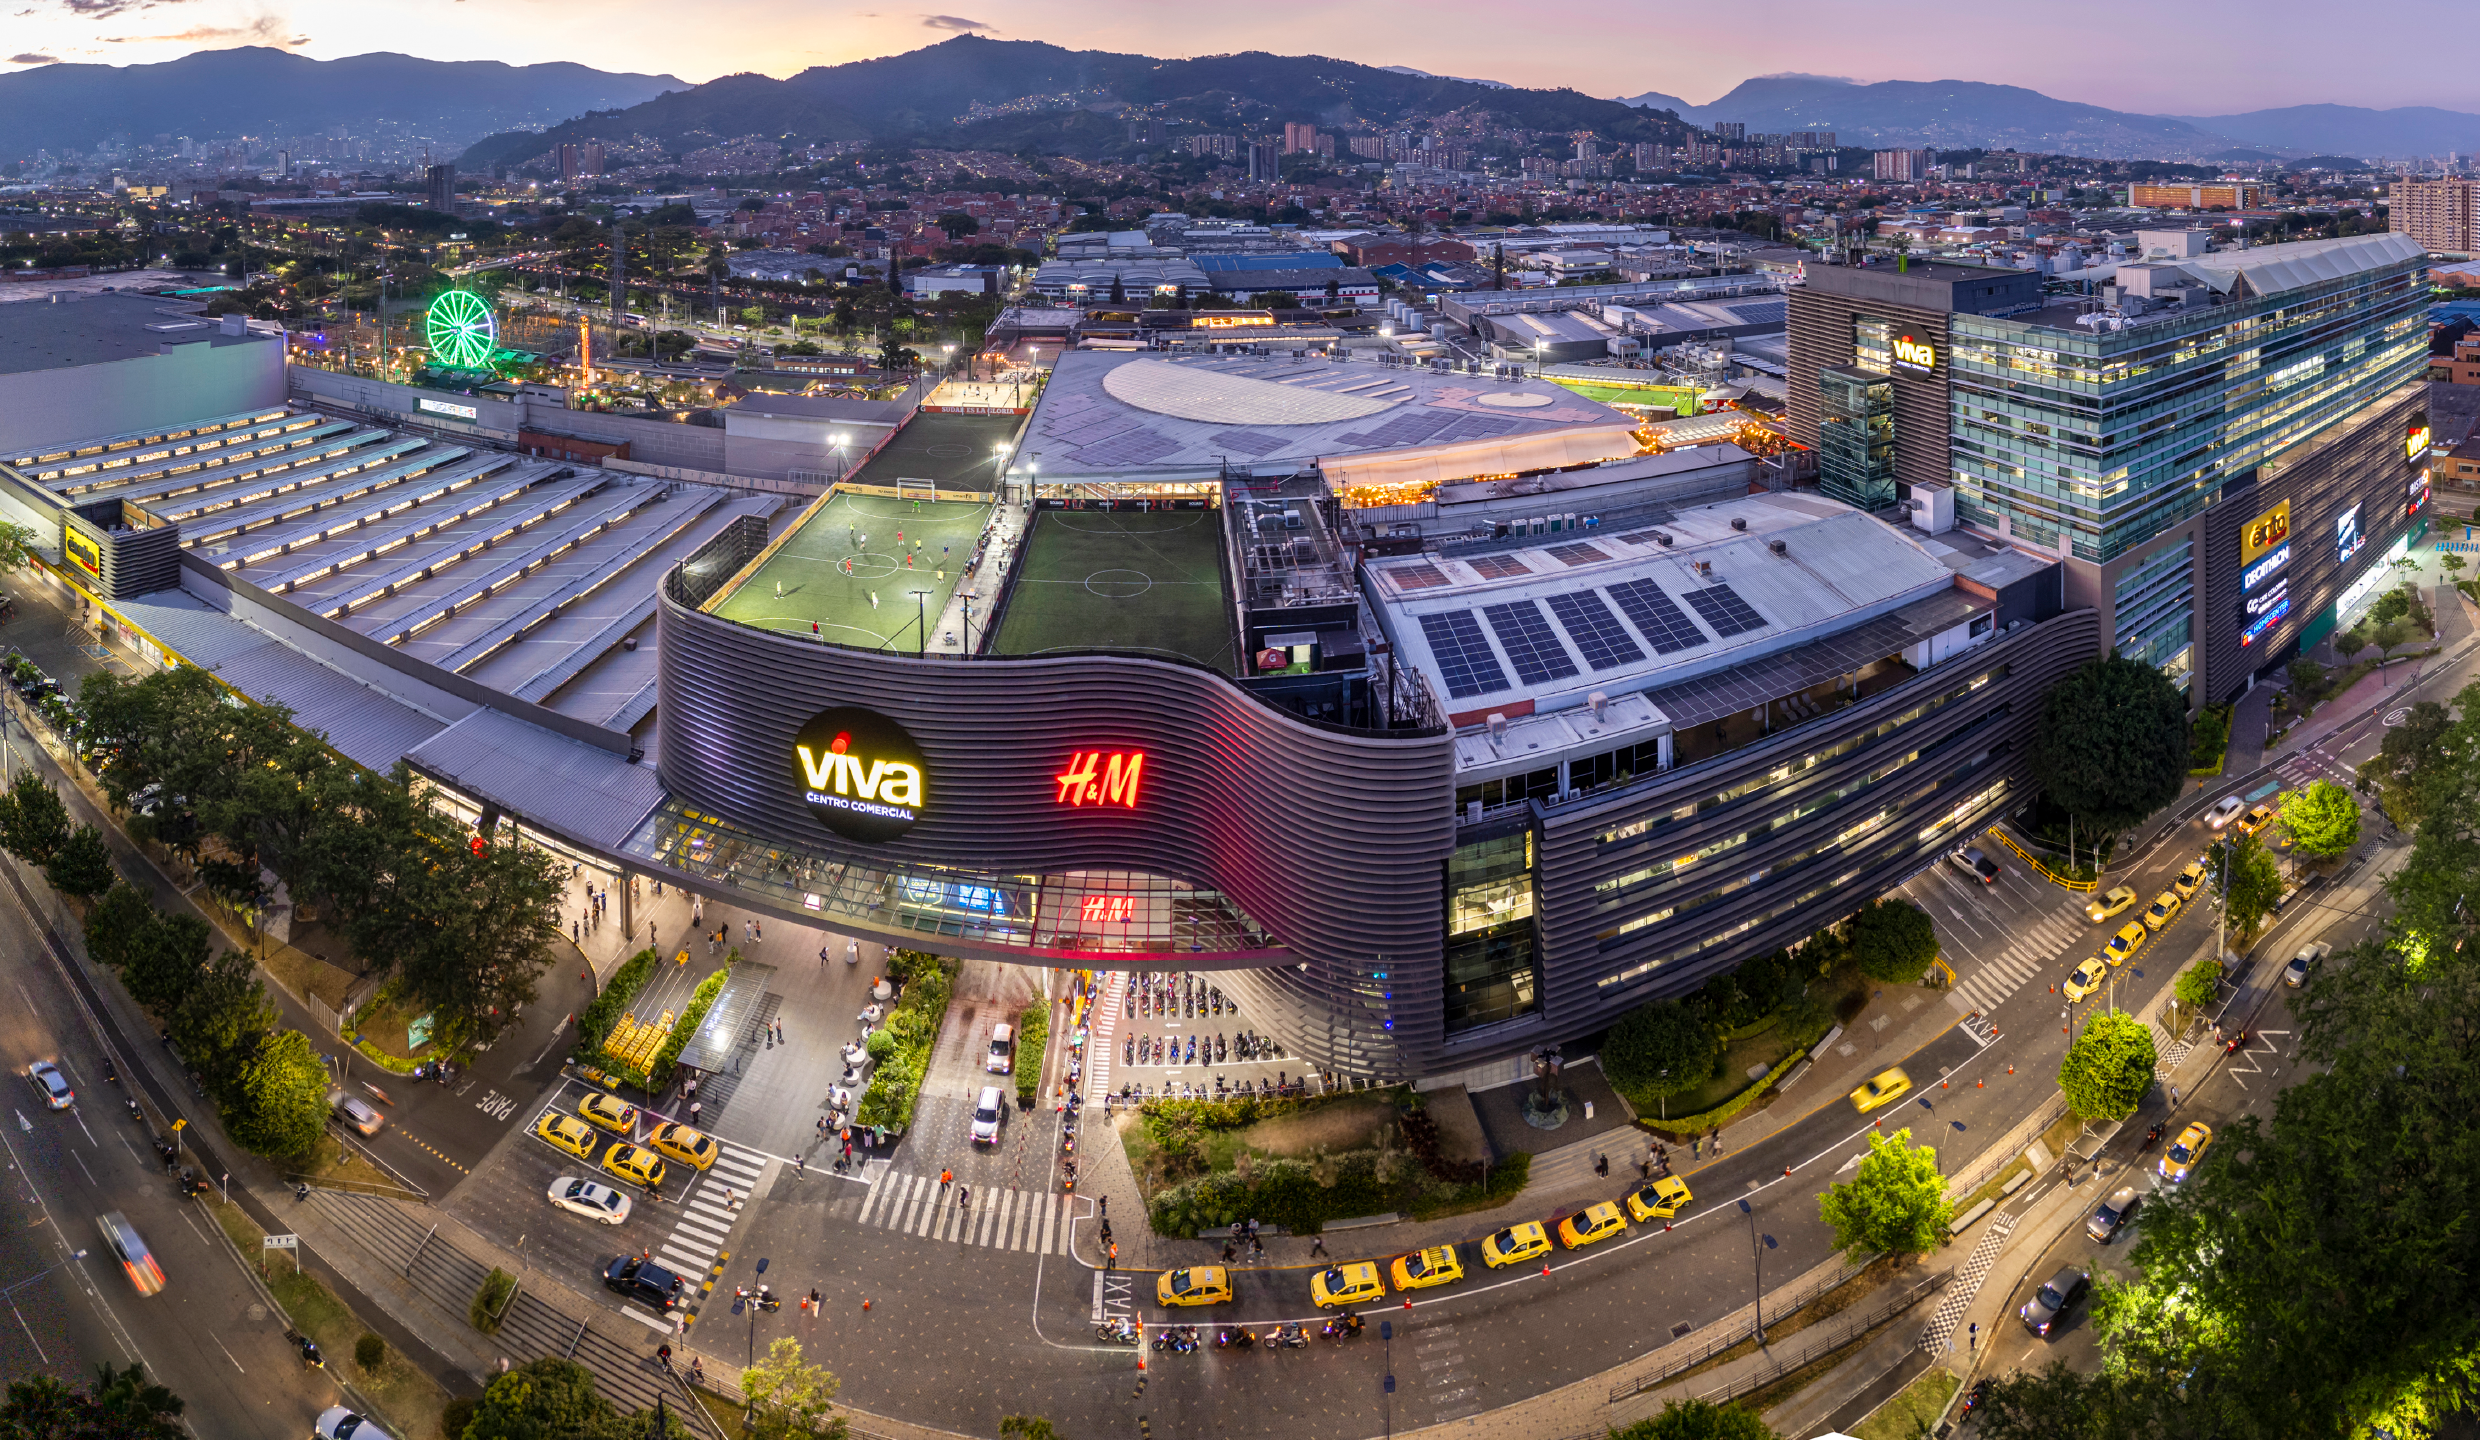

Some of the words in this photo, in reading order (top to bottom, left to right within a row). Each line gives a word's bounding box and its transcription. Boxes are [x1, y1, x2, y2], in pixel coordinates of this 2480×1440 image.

[1893, 335, 1935, 367] viva
[2244, 545, 2290, 589] DECATHLON
[1269, 654, 1277, 663] G
[796, 731, 922, 808] viva
[1057, 751, 1143, 809] H&M
[806, 792, 849, 810] CENTRO
[850, 801, 915, 821] COMERCIAL
[1965, 1015, 1996, 1043] TAXI
[475, 1089, 518, 1121] PARE
[1104, 1275, 1131, 1320] TAXI
